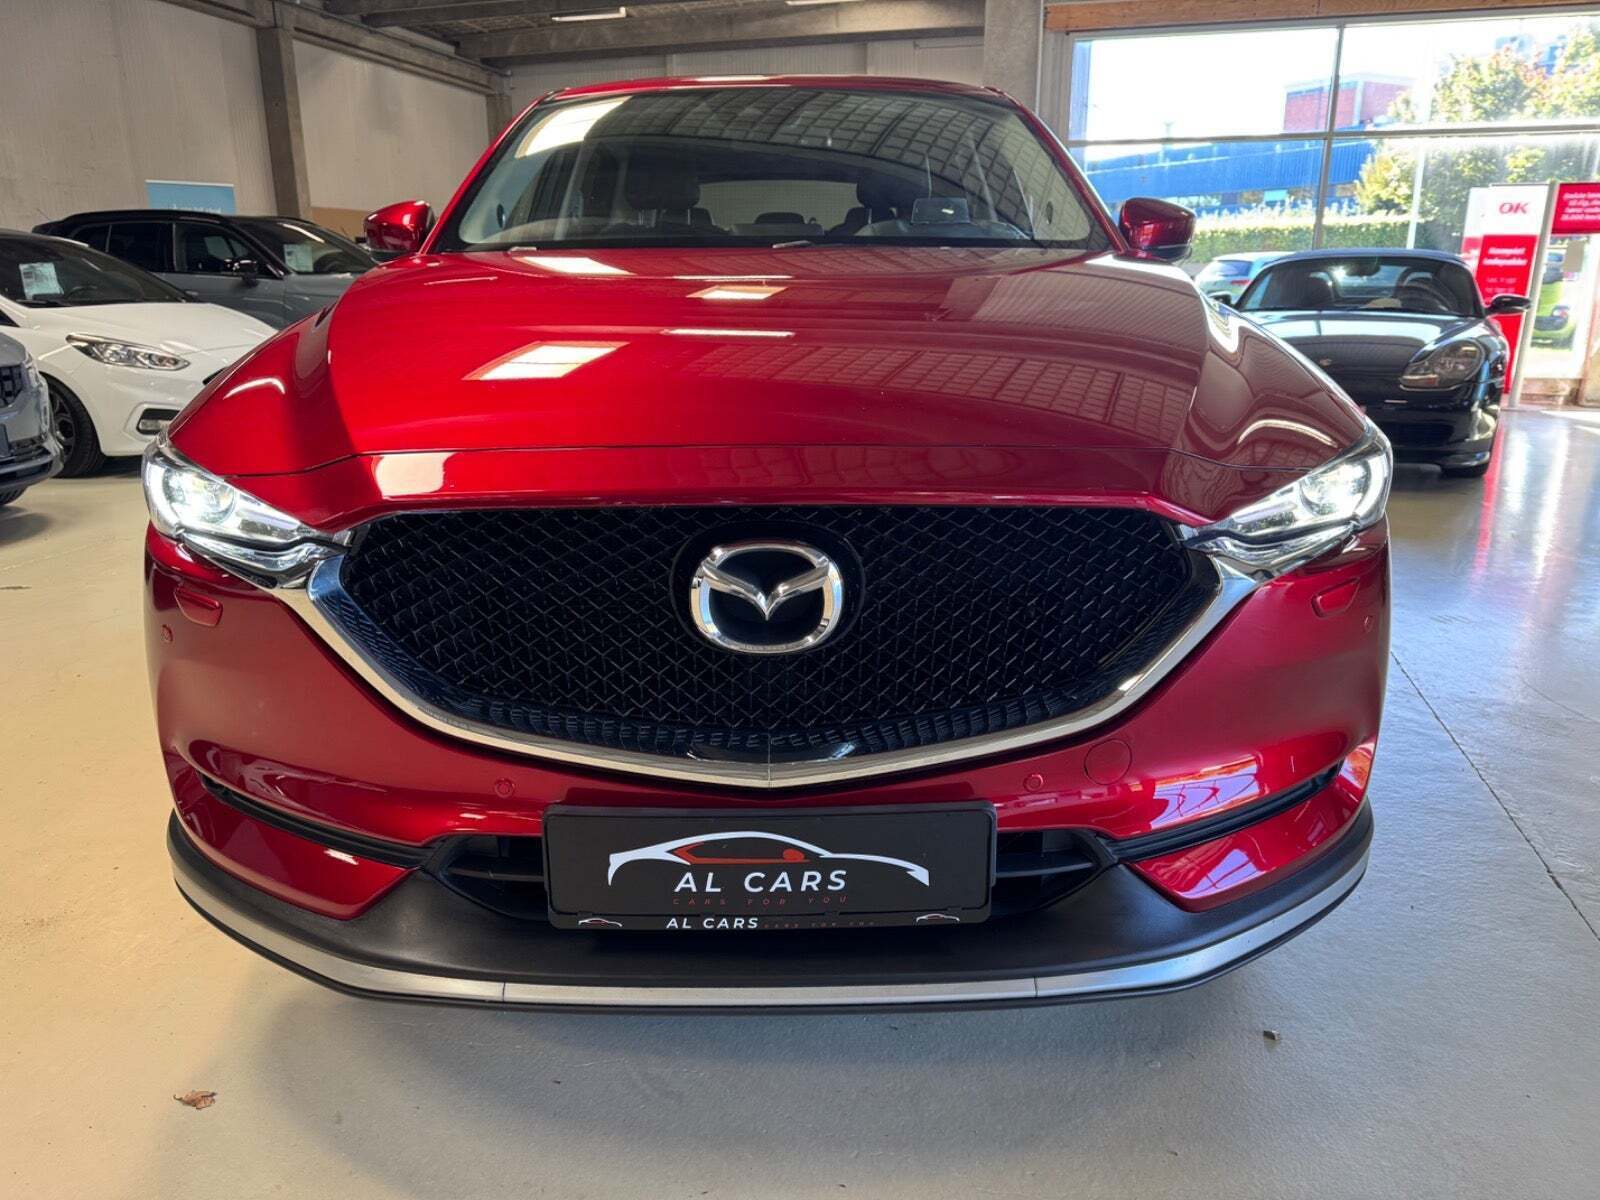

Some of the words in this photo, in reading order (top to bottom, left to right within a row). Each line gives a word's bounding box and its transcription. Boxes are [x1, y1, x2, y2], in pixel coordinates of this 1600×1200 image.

[1499, 202, 1529, 214] OK
[674, 872, 721, 892] AL
[744, 870, 847, 892] CARS
[672, 897, 727, 905] CARS
[747, 898, 786, 906] FOR
[807, 896, 848, 905] YOU
[666, 917, 692, 929] AL
[703, 917, 759, 929] CARS
